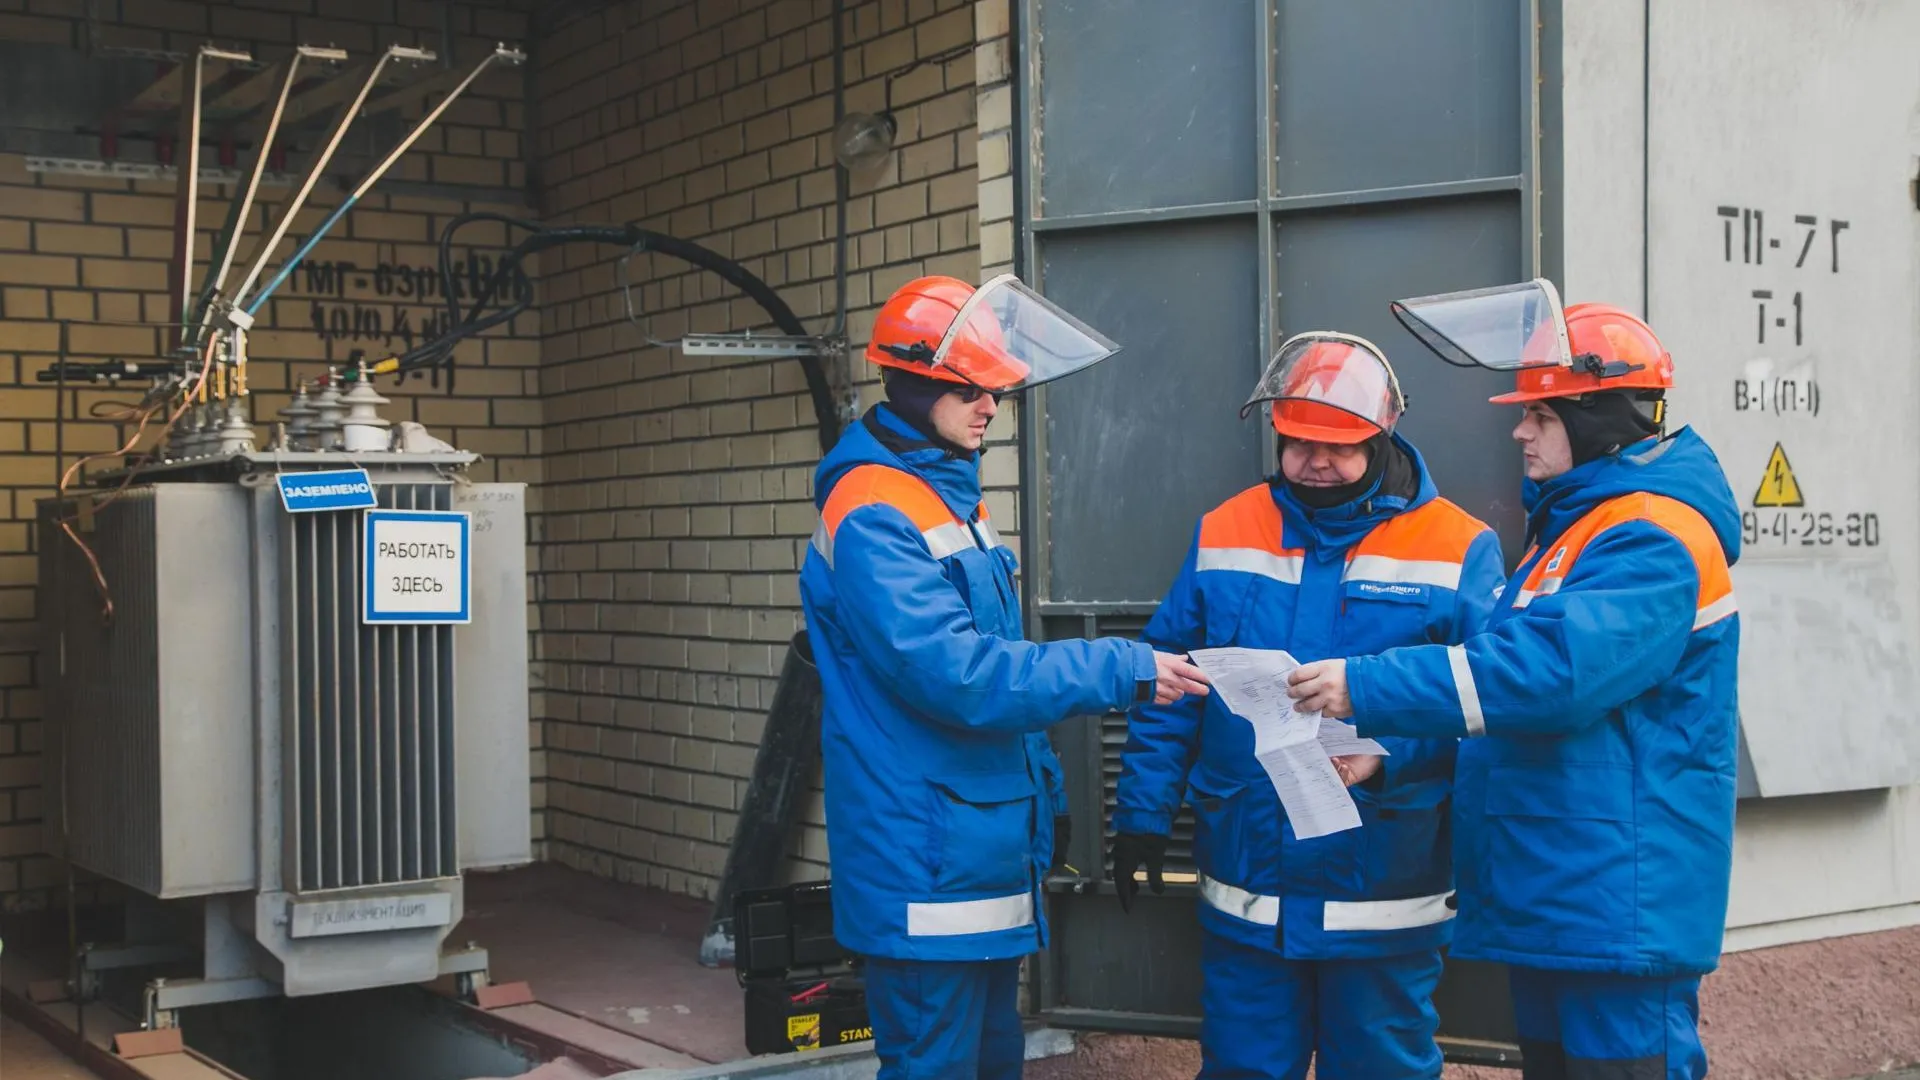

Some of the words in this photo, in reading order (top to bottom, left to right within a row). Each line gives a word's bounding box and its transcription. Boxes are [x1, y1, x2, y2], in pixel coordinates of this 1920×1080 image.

[1752, 290, 1802, 346] Т-1
[284, 482, 370, 498] ЗАЗЕМЛЕНО
[379, 542, 456, 559] РАБОТАТЬ
[392, 576, 443, 595] ЗДЕСЬ
